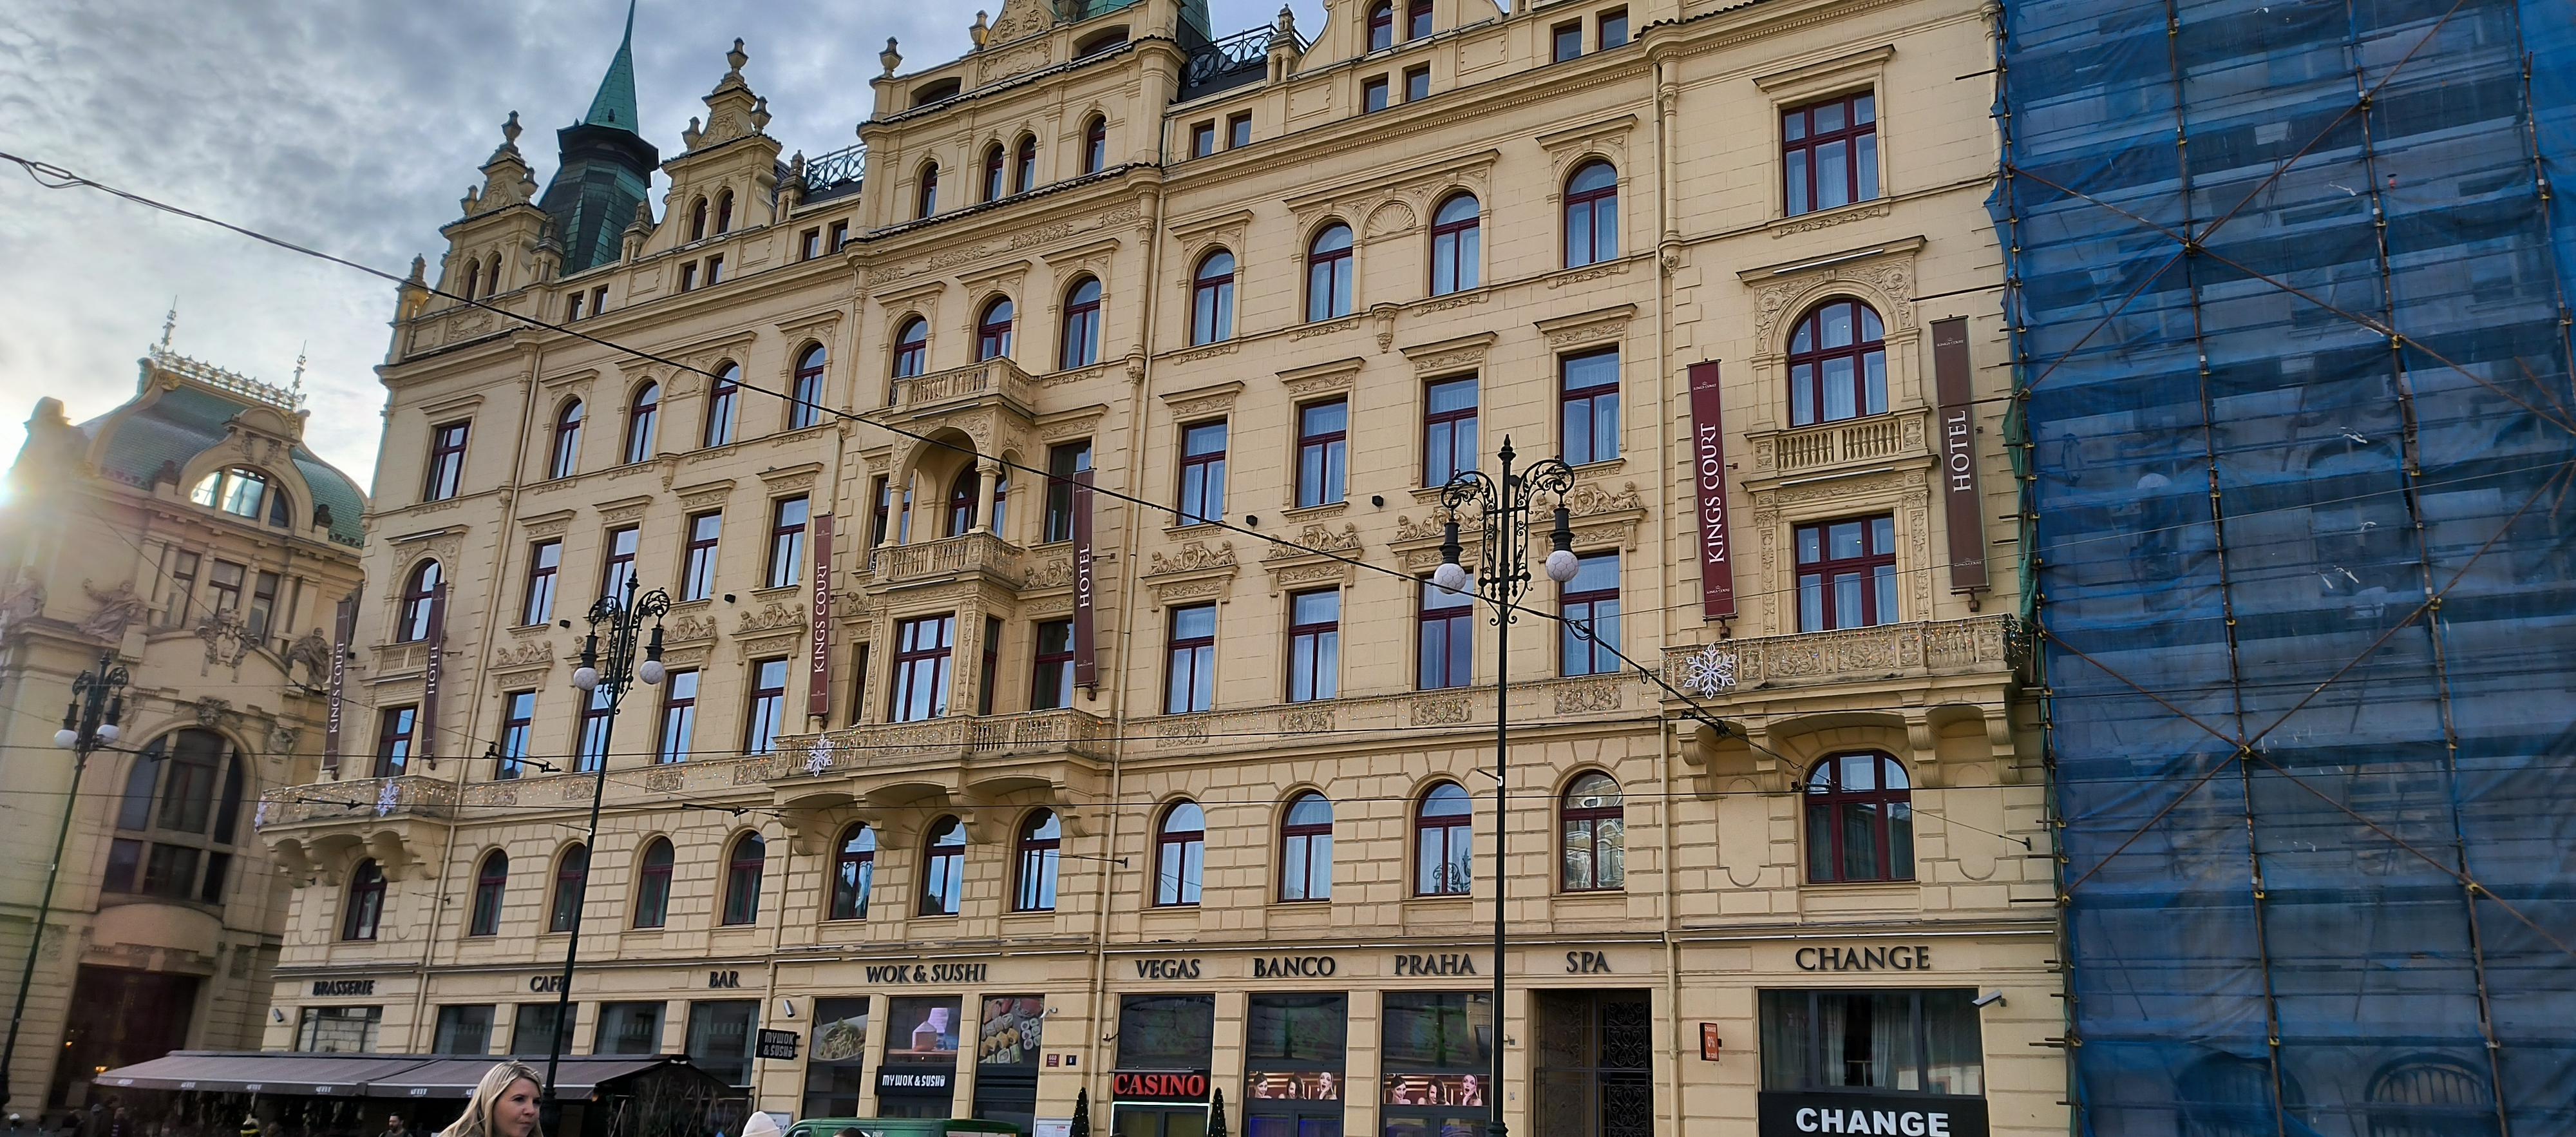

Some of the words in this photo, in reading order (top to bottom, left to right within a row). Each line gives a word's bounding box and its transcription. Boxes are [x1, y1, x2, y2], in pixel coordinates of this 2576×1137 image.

[1700, 423, 1719, 490] COURT
[1948, 410, 1972, 493] HOTEL
[1705, 496, 1725, 564] KINGS
[1079, 544, 1090, 607] HOTEL
[815, 562, 827, 616] COURT
[814, 621, 826, 673] KINGS
[333, 642, 345, 685] COURT
[428, 643, 439, 694] HOTEL
[329, 689, 341, 733] KINGS
[1135, 959, 1200, 979] VEGAS
[1253, 956, 1336, 977] BANCO
[1394, 953, 1476, 975] PRAHA
[1566, 951, 1611, 973] SPA
[1795, 946, 1931, 970] CHANGE
[709, 971, 741, 988] BAR
[866, 965, 911, 983] WOK
[913, 964, 927, 982] &
[931, 963, 987, 982] SUSHI
[312, 980, 375, 996] BRASSERIE
[763, 1046, 770, 1056] &
[914, 1075, 921, 1086] &
[1113, 1074, 1205, 1096] CASINO
[1796, 1107, 1950, 1137] CHANGE
